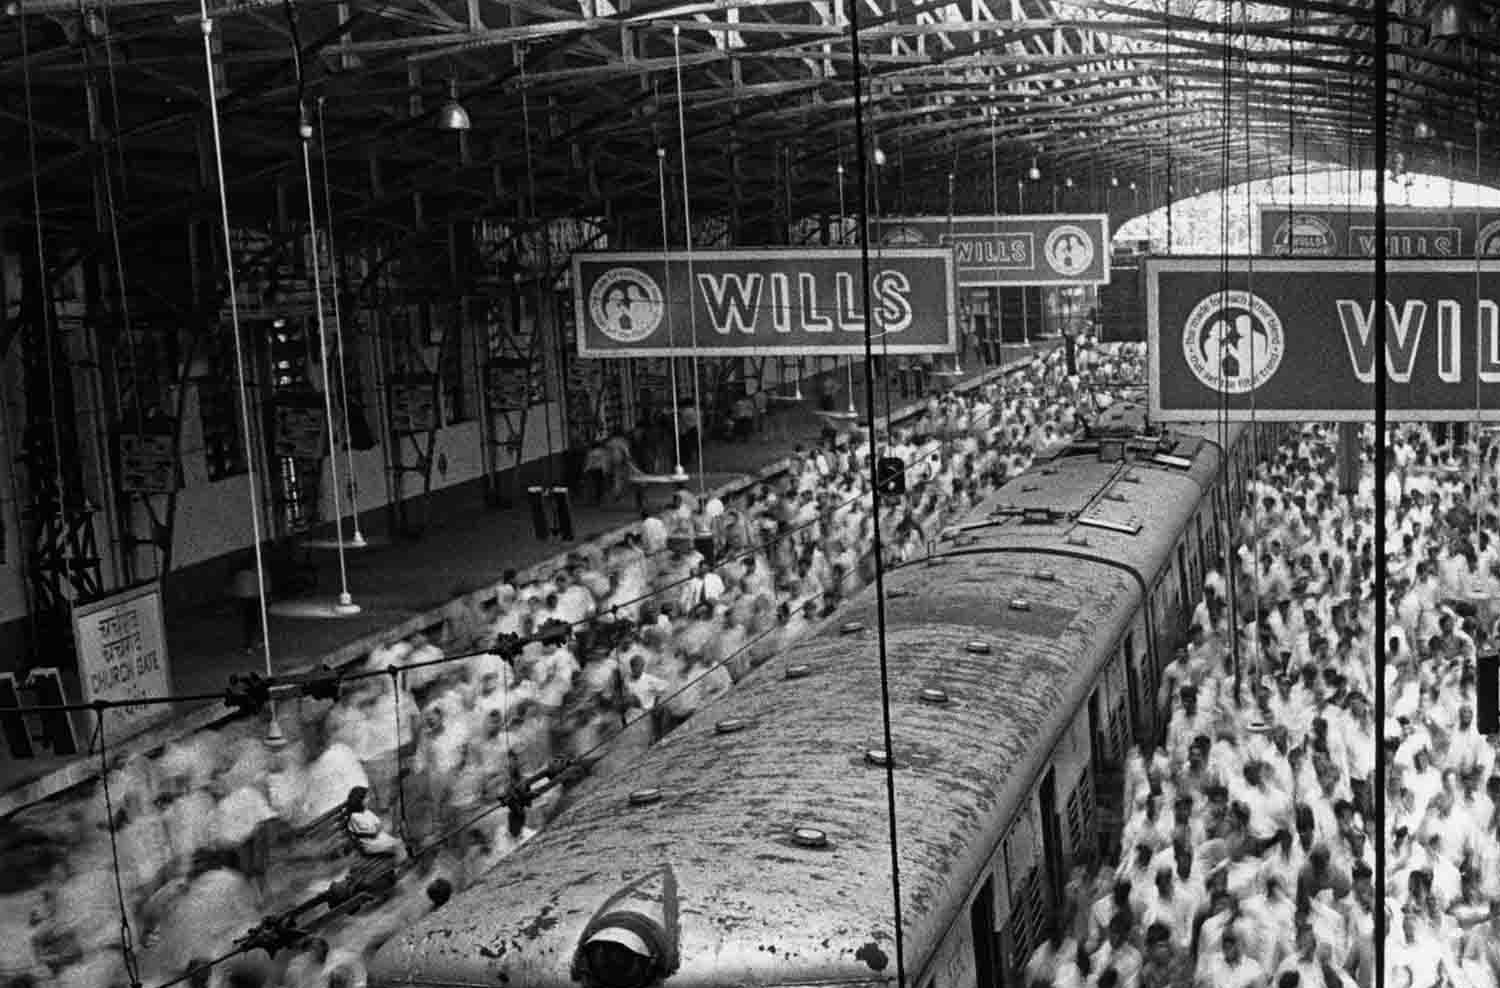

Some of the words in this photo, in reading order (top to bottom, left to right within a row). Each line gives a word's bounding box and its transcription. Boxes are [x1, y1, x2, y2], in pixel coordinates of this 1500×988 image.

[955, 240, 1026, 262] WILLS
[696, 269, 912, 334] WILLS
[136, 650, 160, 676] GATE
